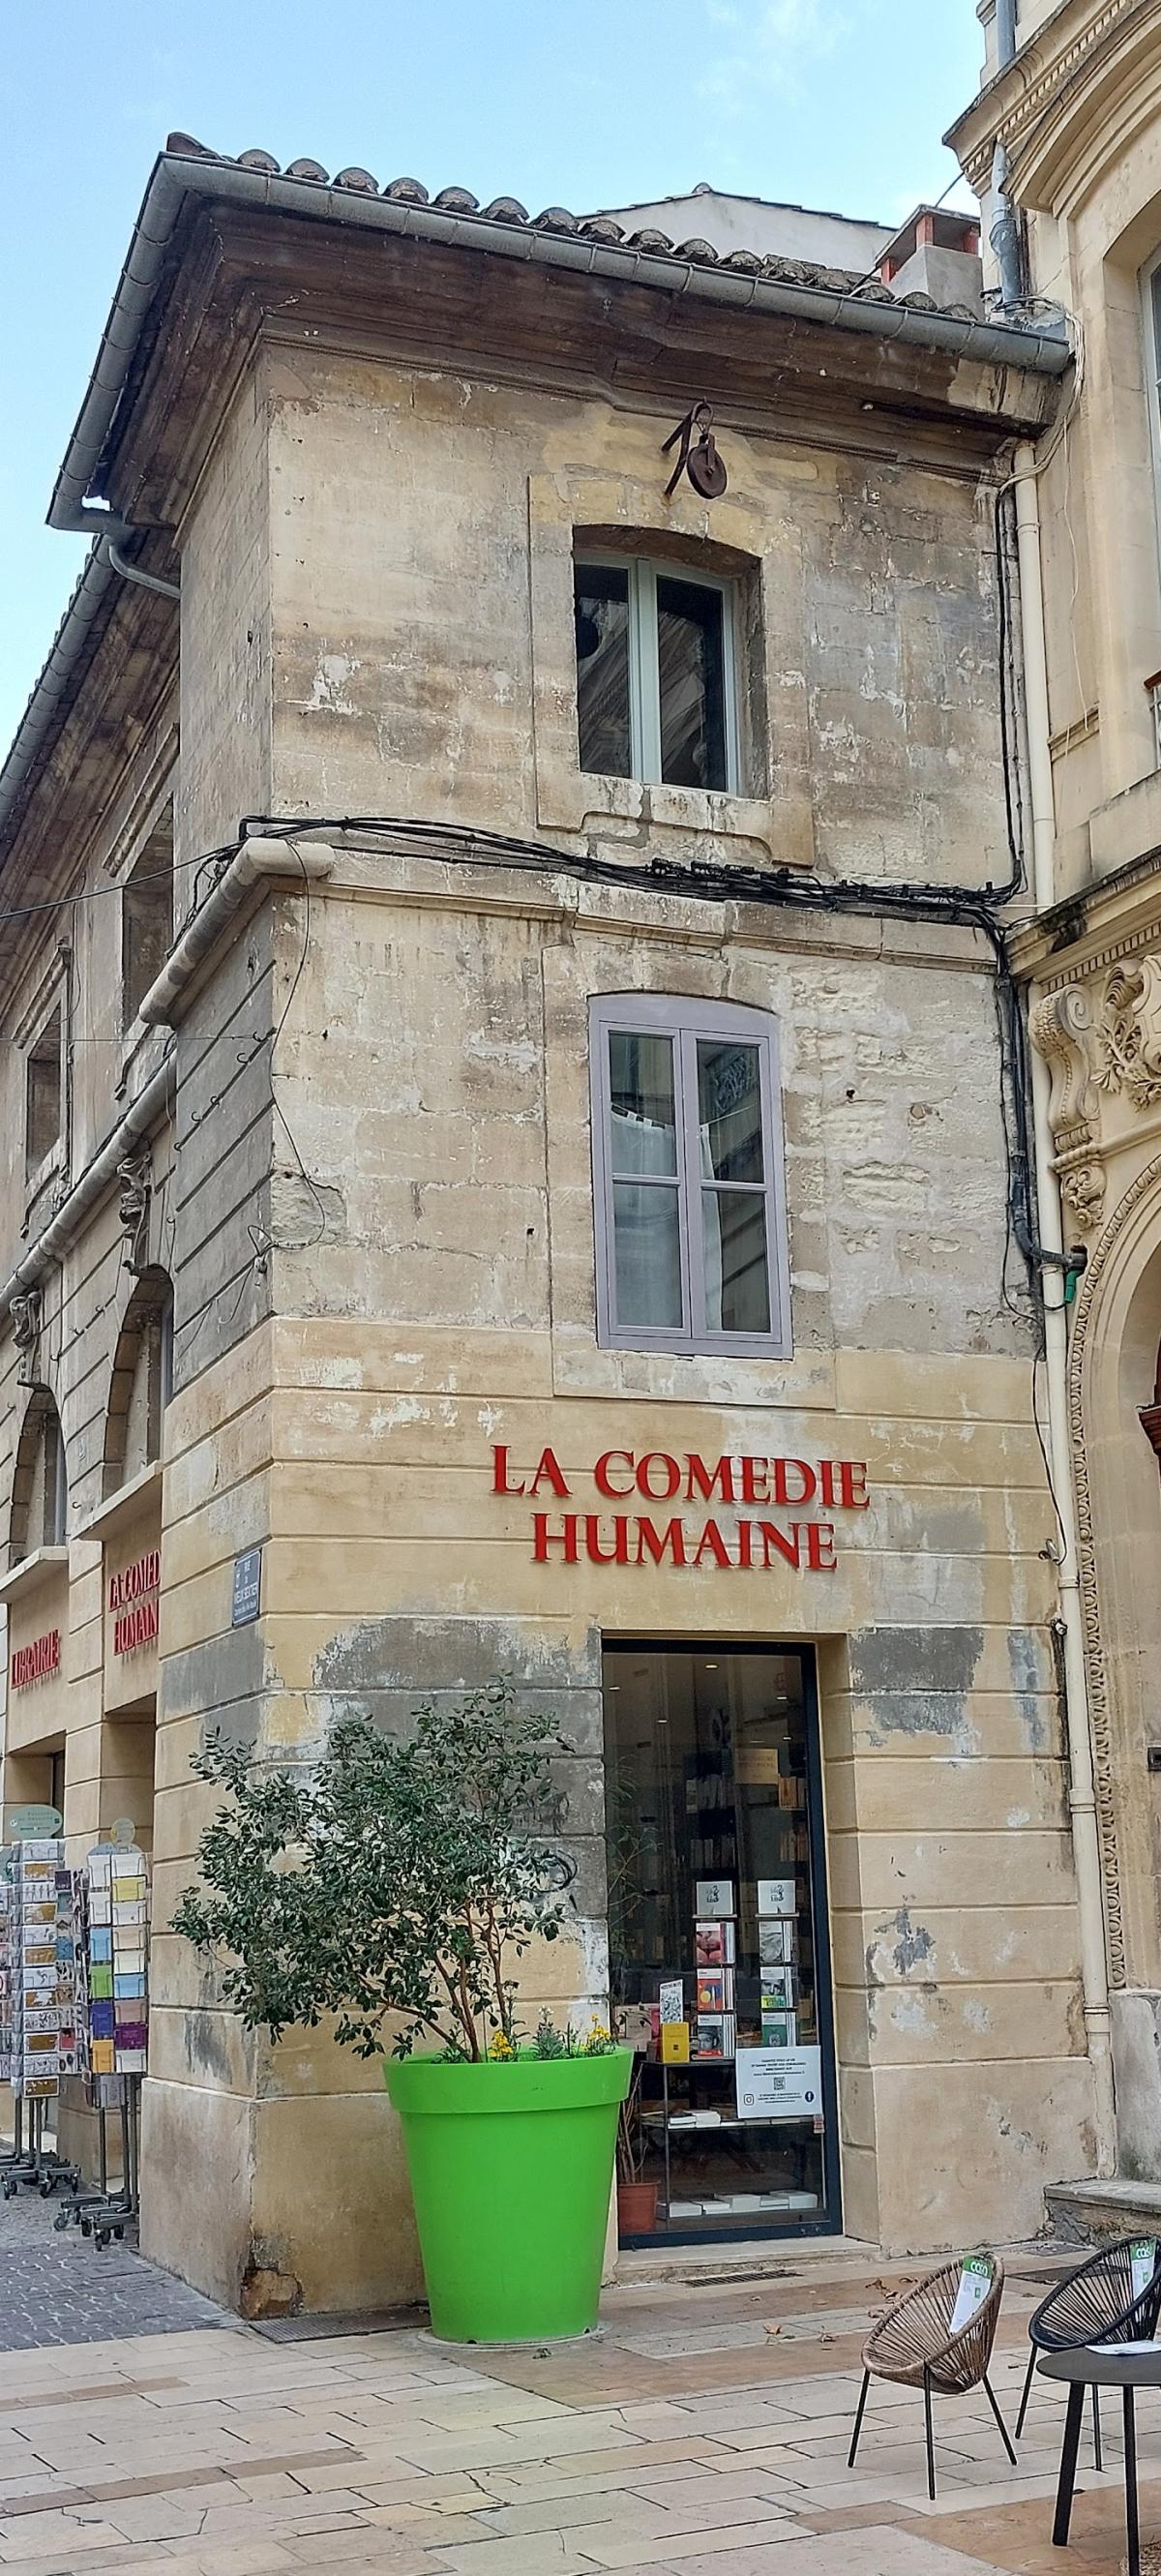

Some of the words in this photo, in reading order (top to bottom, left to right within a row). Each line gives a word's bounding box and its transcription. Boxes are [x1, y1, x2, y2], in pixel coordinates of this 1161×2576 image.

[490, 1445, 573, 1496] LA
[594, 1451, 871, 1509] COMEDIE
[529, 1513, 838, 1572] HUMAINE
[109, 1573, 124, 1612] LA
[123, 1549, 162, 1603] COMED
[114, 1598, 160, 1656] HUMAIN
[11, 1629, 59, 1690] LIBRAIRIE
